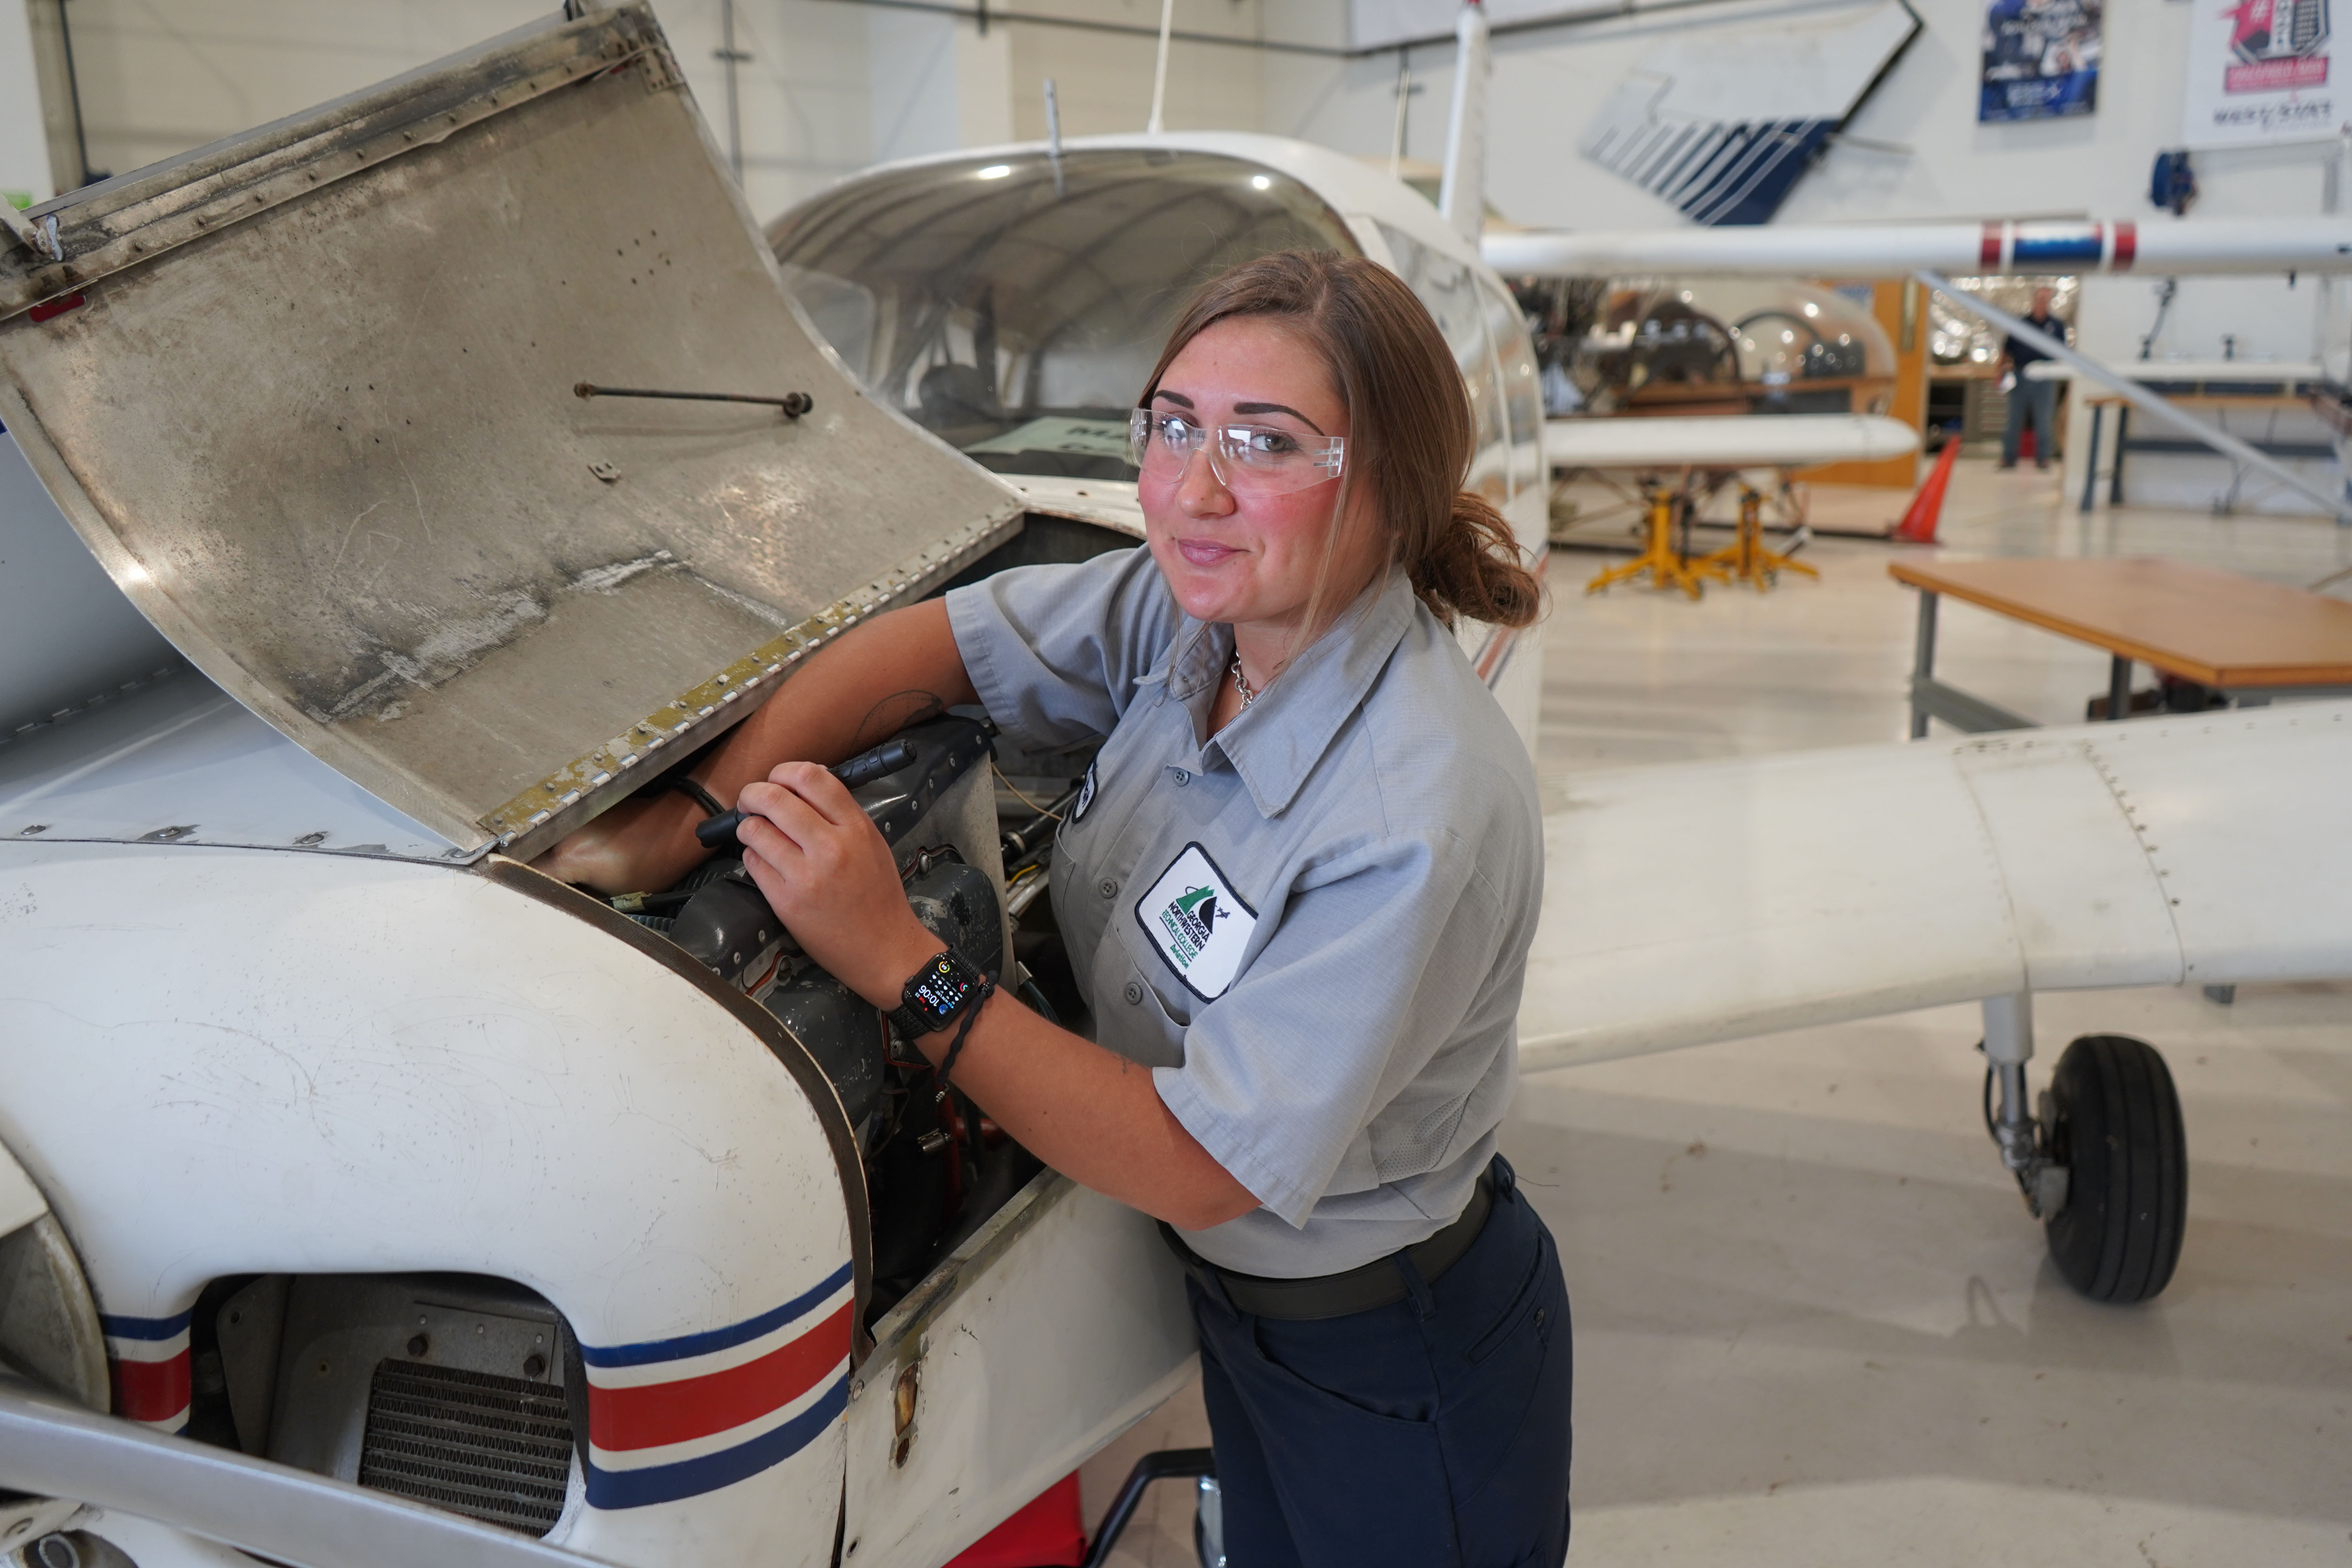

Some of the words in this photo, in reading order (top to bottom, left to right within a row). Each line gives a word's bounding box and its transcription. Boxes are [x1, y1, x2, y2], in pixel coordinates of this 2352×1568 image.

[1161, 909, 1180, 937] TECHNICAL
[1177, 933, 1198, 959] COLLEGE
[1168, 901, 1205, 951] NORTHWESTERN
[1187, 910, 1210, 943] GEORGIA
[918, 985, 939, 1006] 10:06
